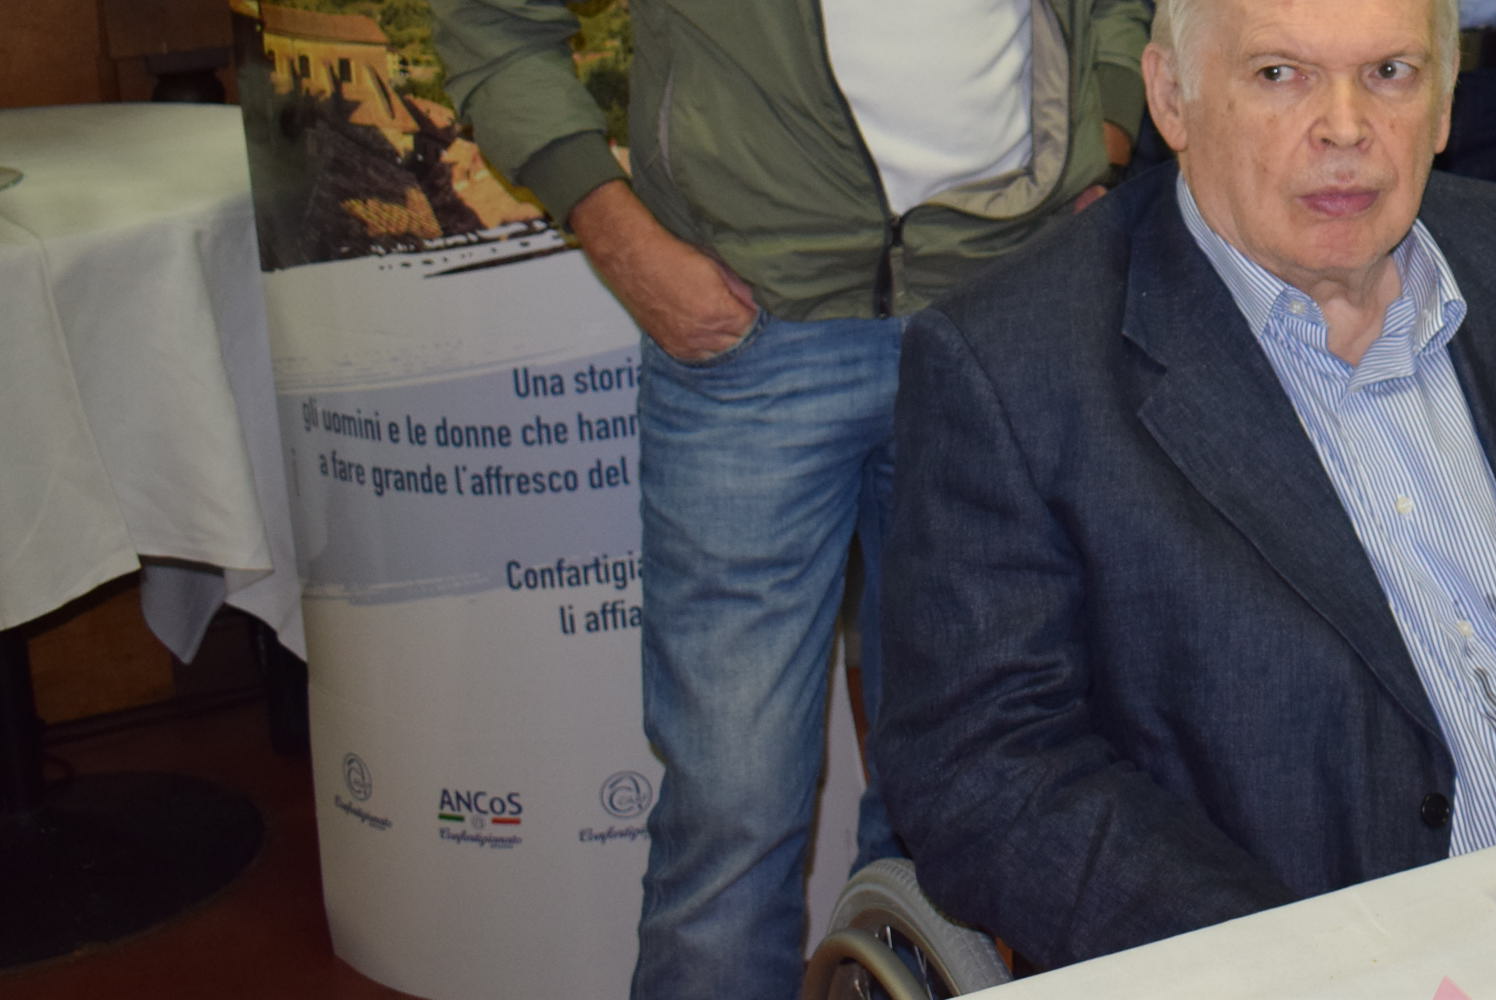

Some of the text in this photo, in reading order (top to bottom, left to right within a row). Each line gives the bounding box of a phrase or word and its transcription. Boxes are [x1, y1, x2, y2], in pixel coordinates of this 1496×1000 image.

[512, 367, 565, 398] Una
[302, 398, 318, 432] gli
[322, 408, 382, 441] uomini
[388, 421, 400, 443] e
[406, 414, 427, 446] le
[435, 417, 512, 448] donne
[521, 415, 567, 446] che
[319, 450, 630, 497] a fare grande l'affresco del
[561, 606, 576, 635] li
[439, 788, 523, 816] ANCoS
